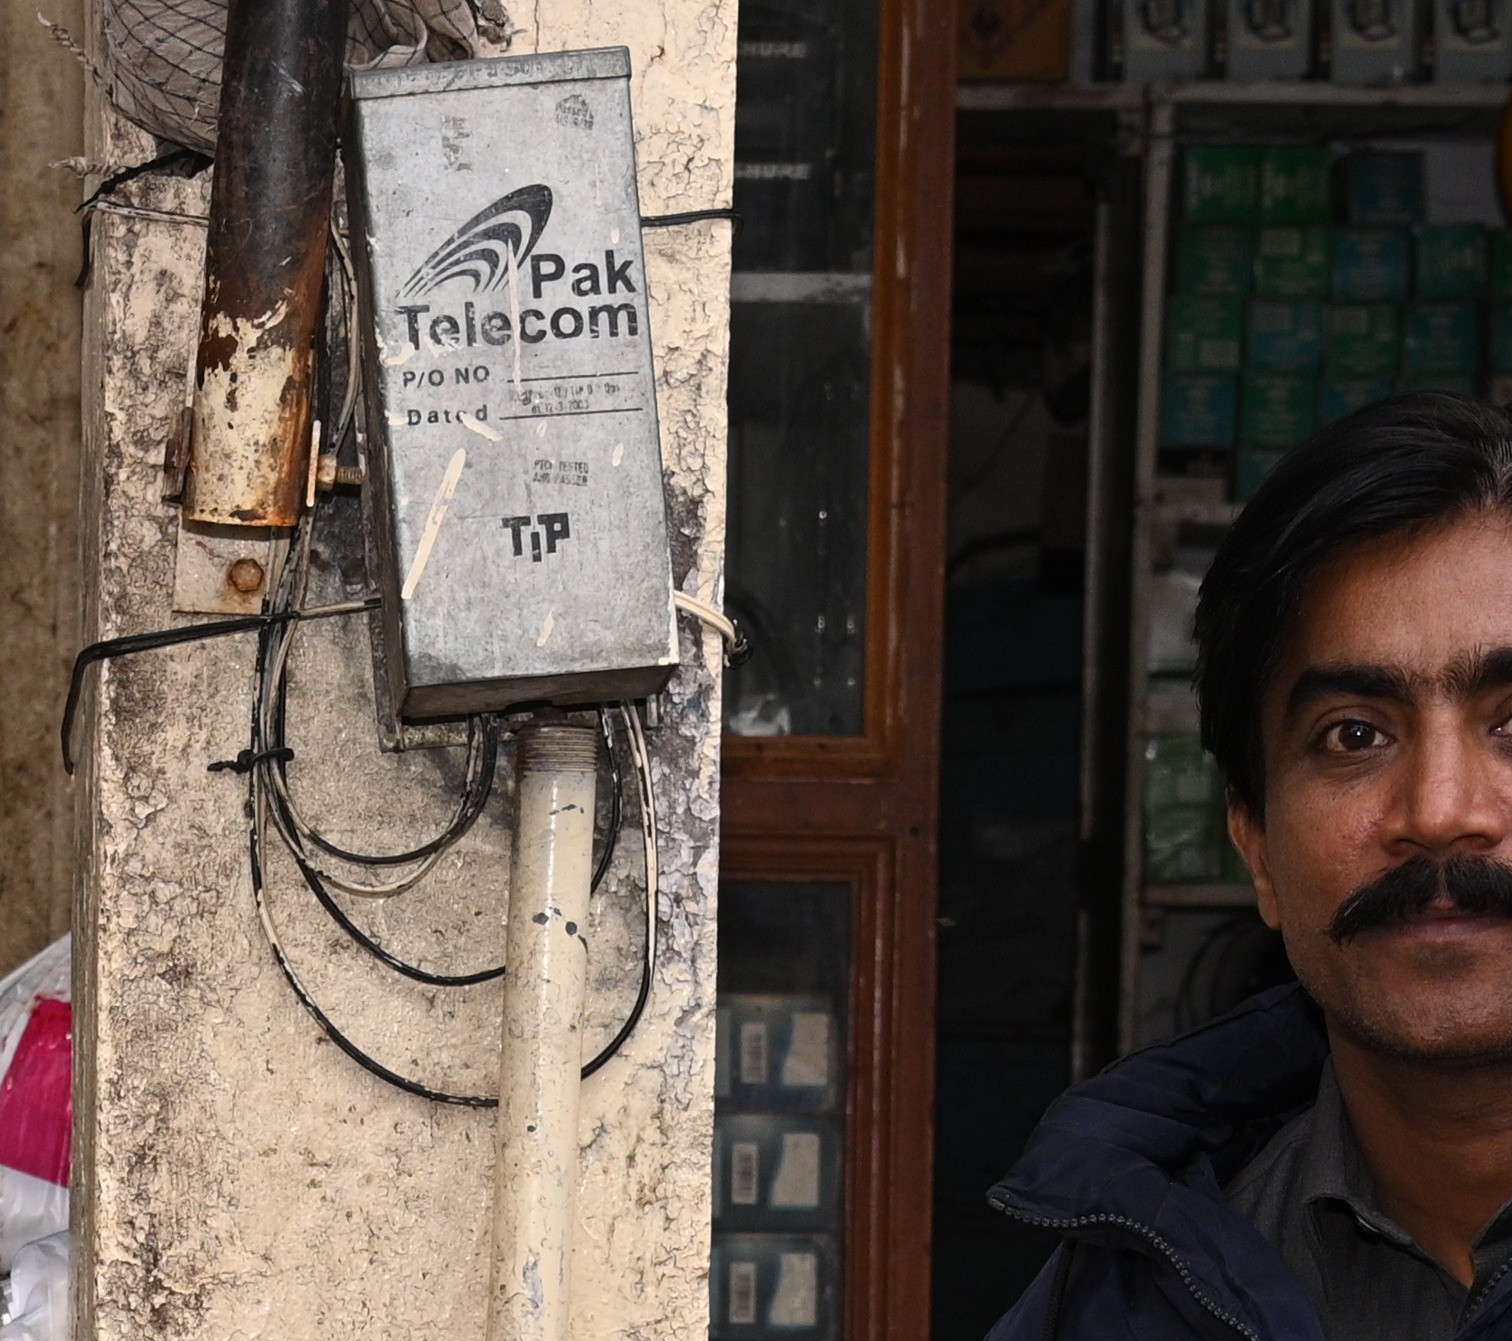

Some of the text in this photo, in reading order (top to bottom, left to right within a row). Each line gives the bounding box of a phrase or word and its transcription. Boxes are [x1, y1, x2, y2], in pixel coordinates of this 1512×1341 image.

[531, 250, 637, 299] Pak
[395, 302, 639, 350] Telecom
[403, 365, 490, 389] P/O NO
